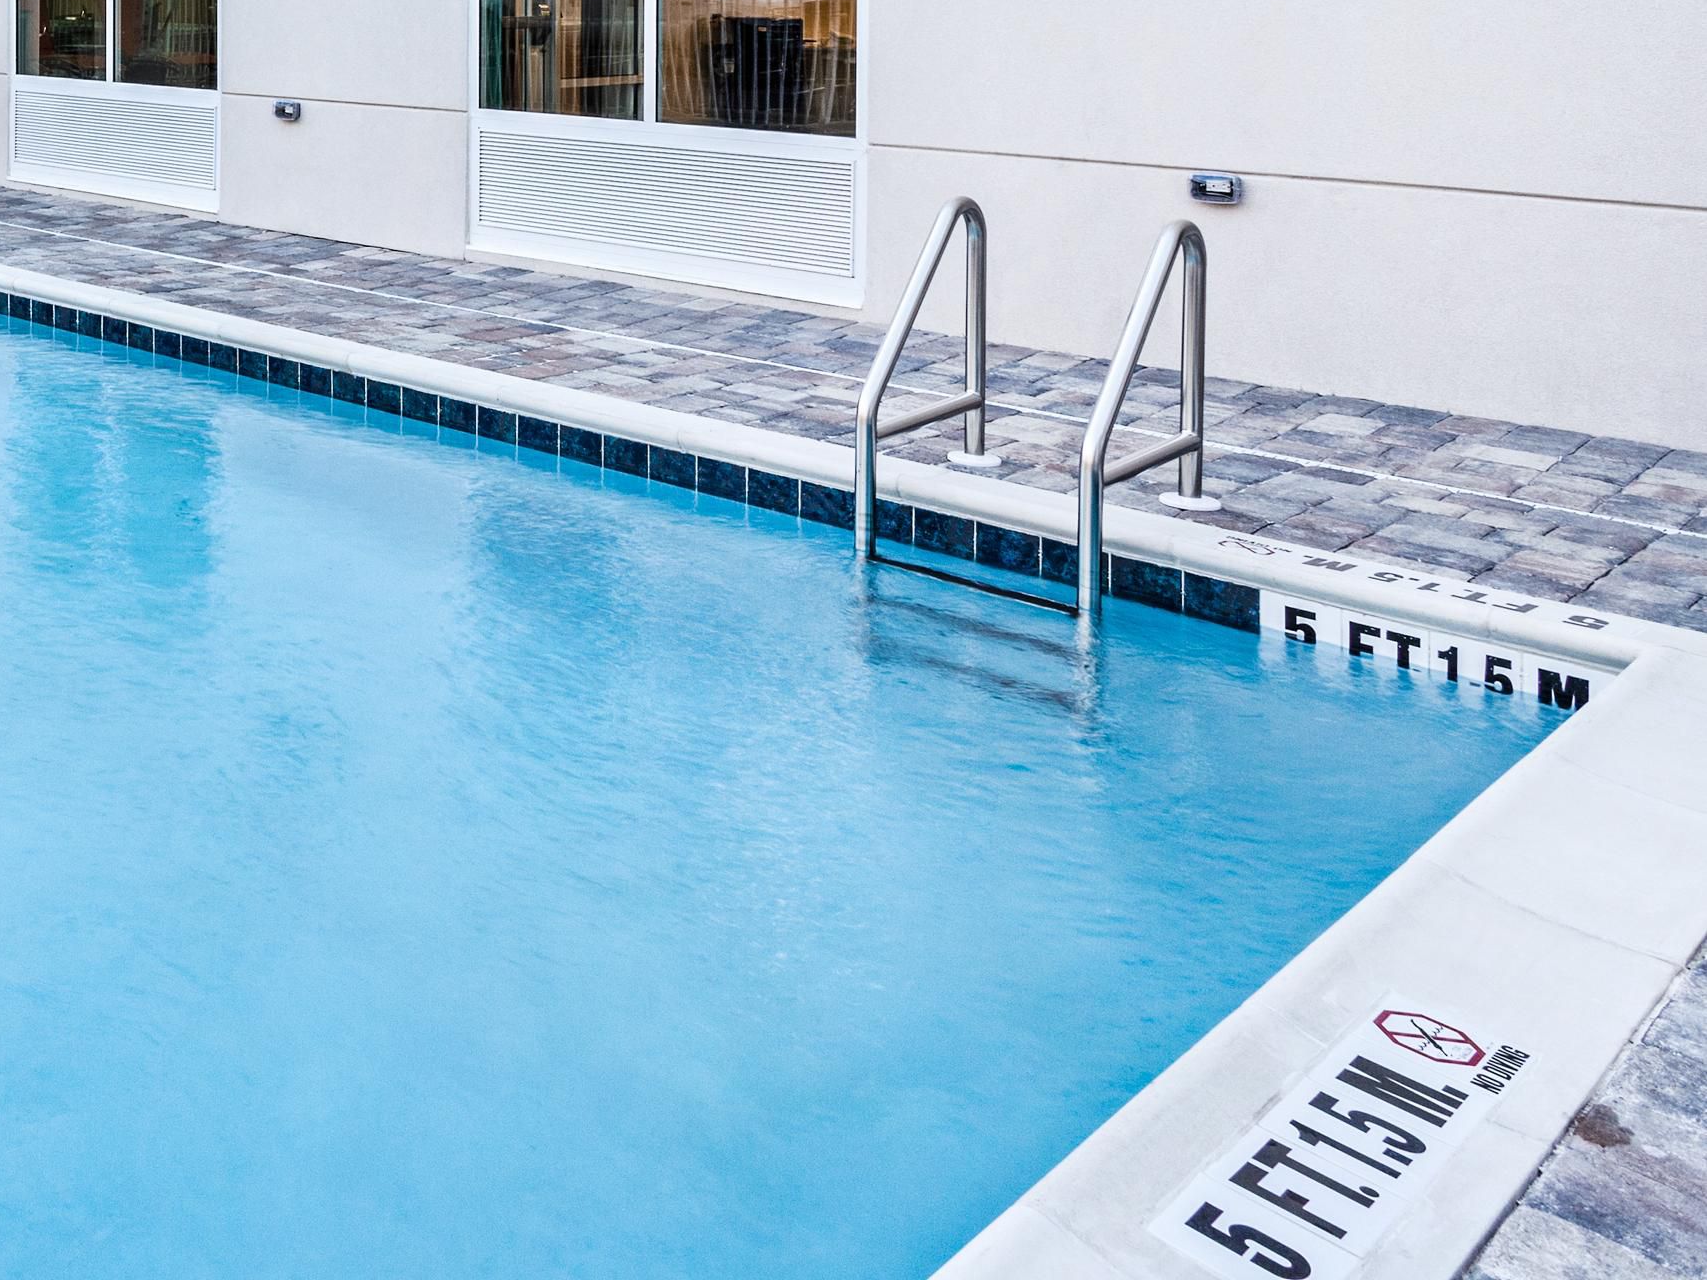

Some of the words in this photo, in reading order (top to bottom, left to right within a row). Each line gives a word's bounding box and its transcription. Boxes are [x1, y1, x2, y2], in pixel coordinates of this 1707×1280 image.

[1284, 605, 1317, 645] 5
[1561, 614, 1610, 631] 5
[1482, 1045, 1531, 1081] DIVING
[1470, 1073, 1506, 1095] NO
[1184, 1200, 1312, 1280] 5
